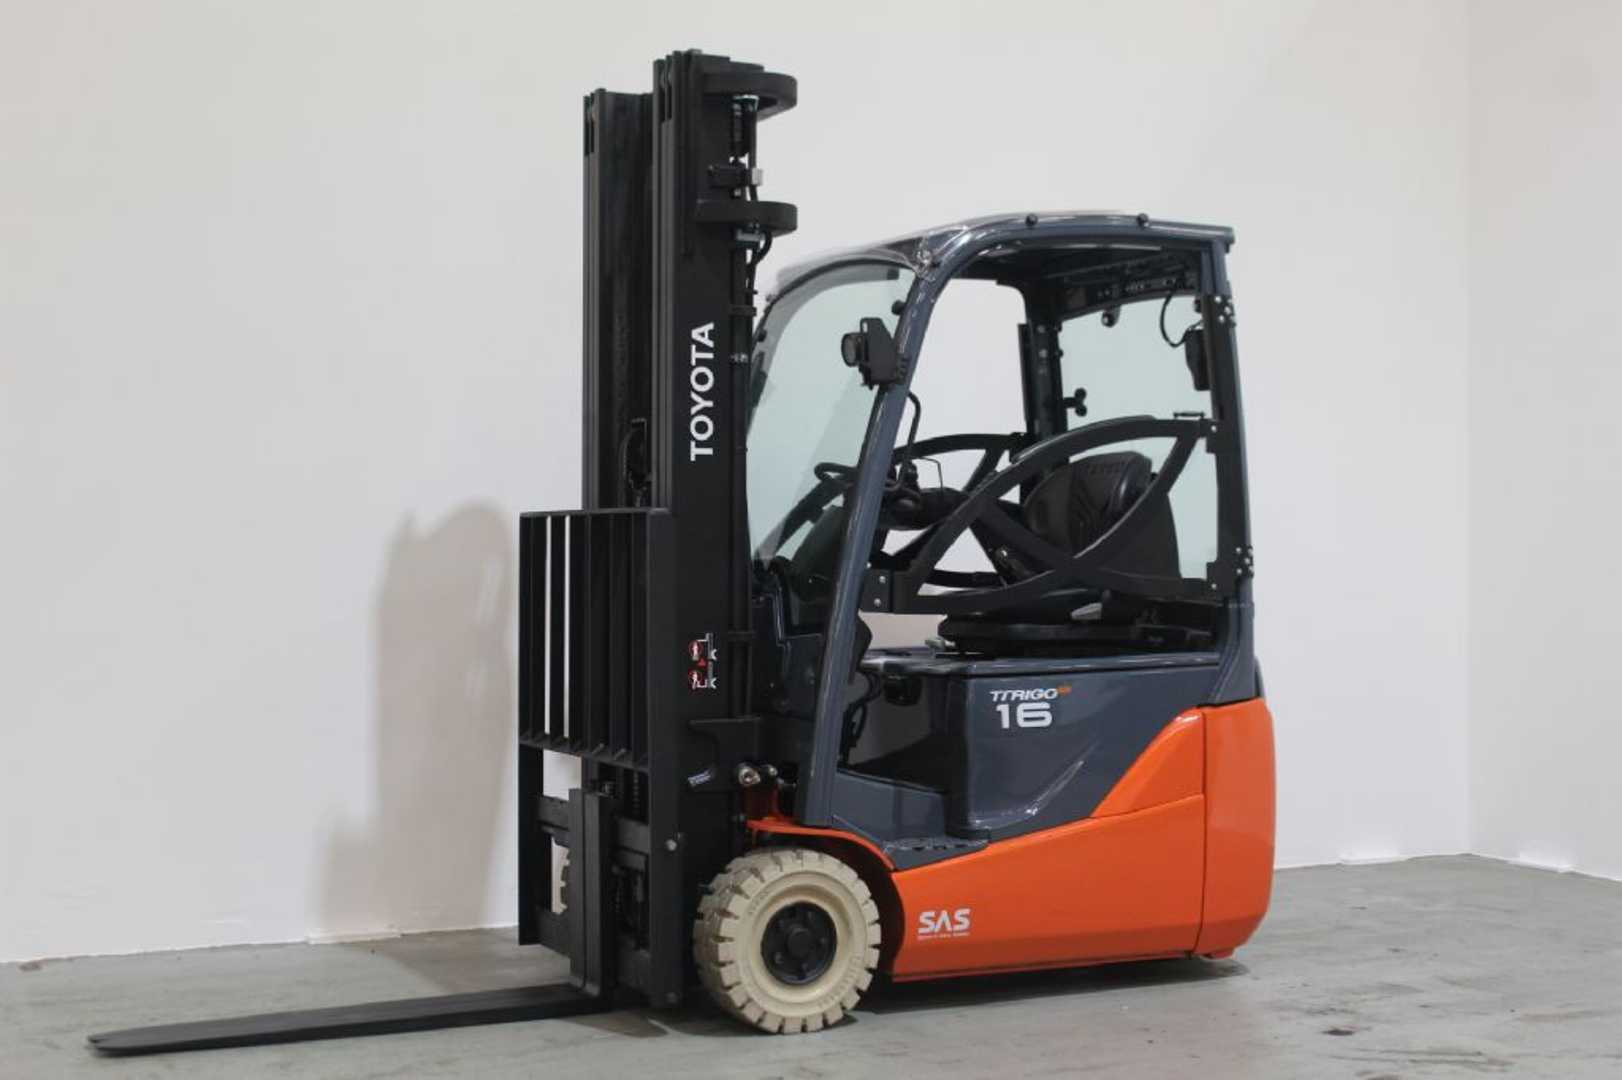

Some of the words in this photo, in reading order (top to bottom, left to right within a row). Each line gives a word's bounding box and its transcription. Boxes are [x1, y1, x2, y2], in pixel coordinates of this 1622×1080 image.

[690, 322, 715, 461] TOYOTA
[996, 702, 1053, 729] 16
[918, 908, 971, 933] SAS
